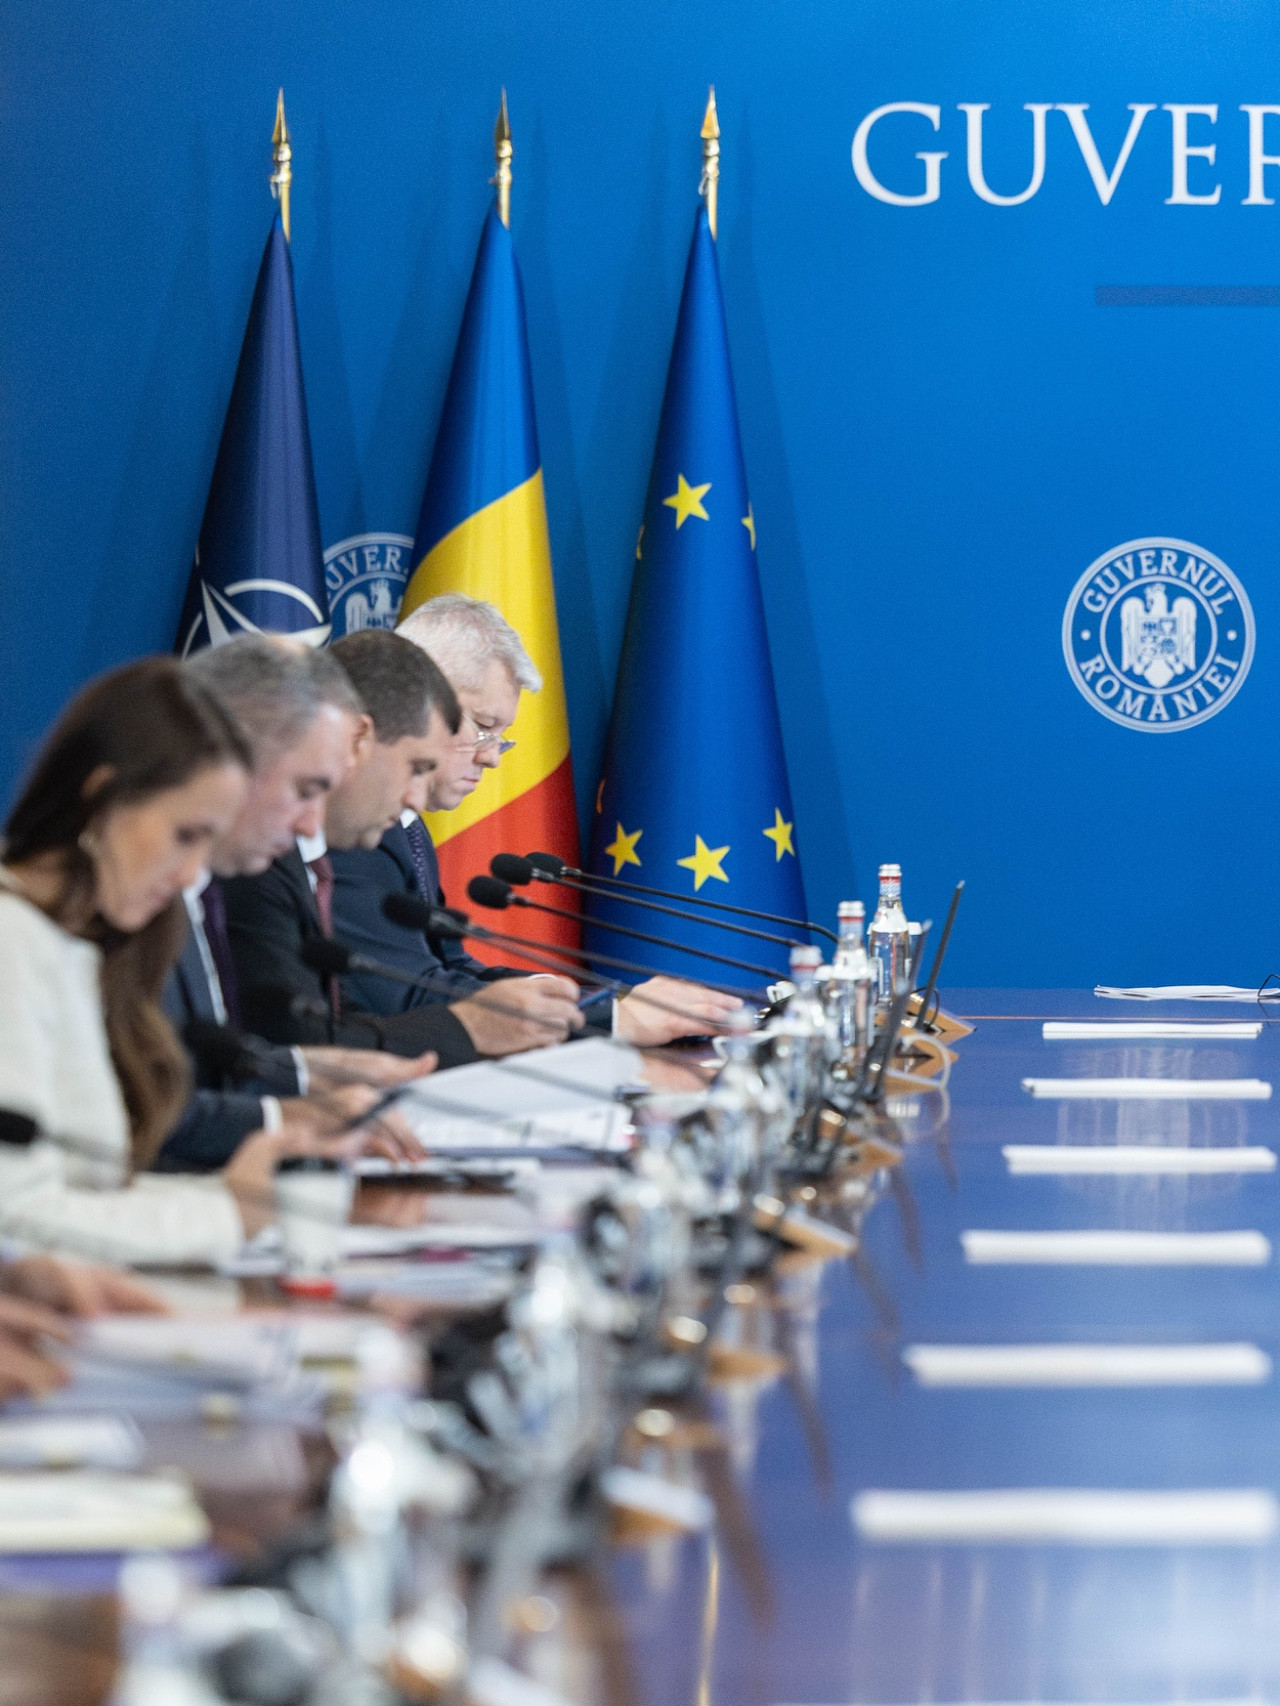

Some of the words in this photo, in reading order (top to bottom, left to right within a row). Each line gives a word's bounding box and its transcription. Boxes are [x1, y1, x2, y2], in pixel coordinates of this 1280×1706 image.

[325, 545, 409, 595] UVER
[1082, 549, 1235, 615] GUVERNUL
[1079, 653, 1239, 721] ROMÂNIEI
